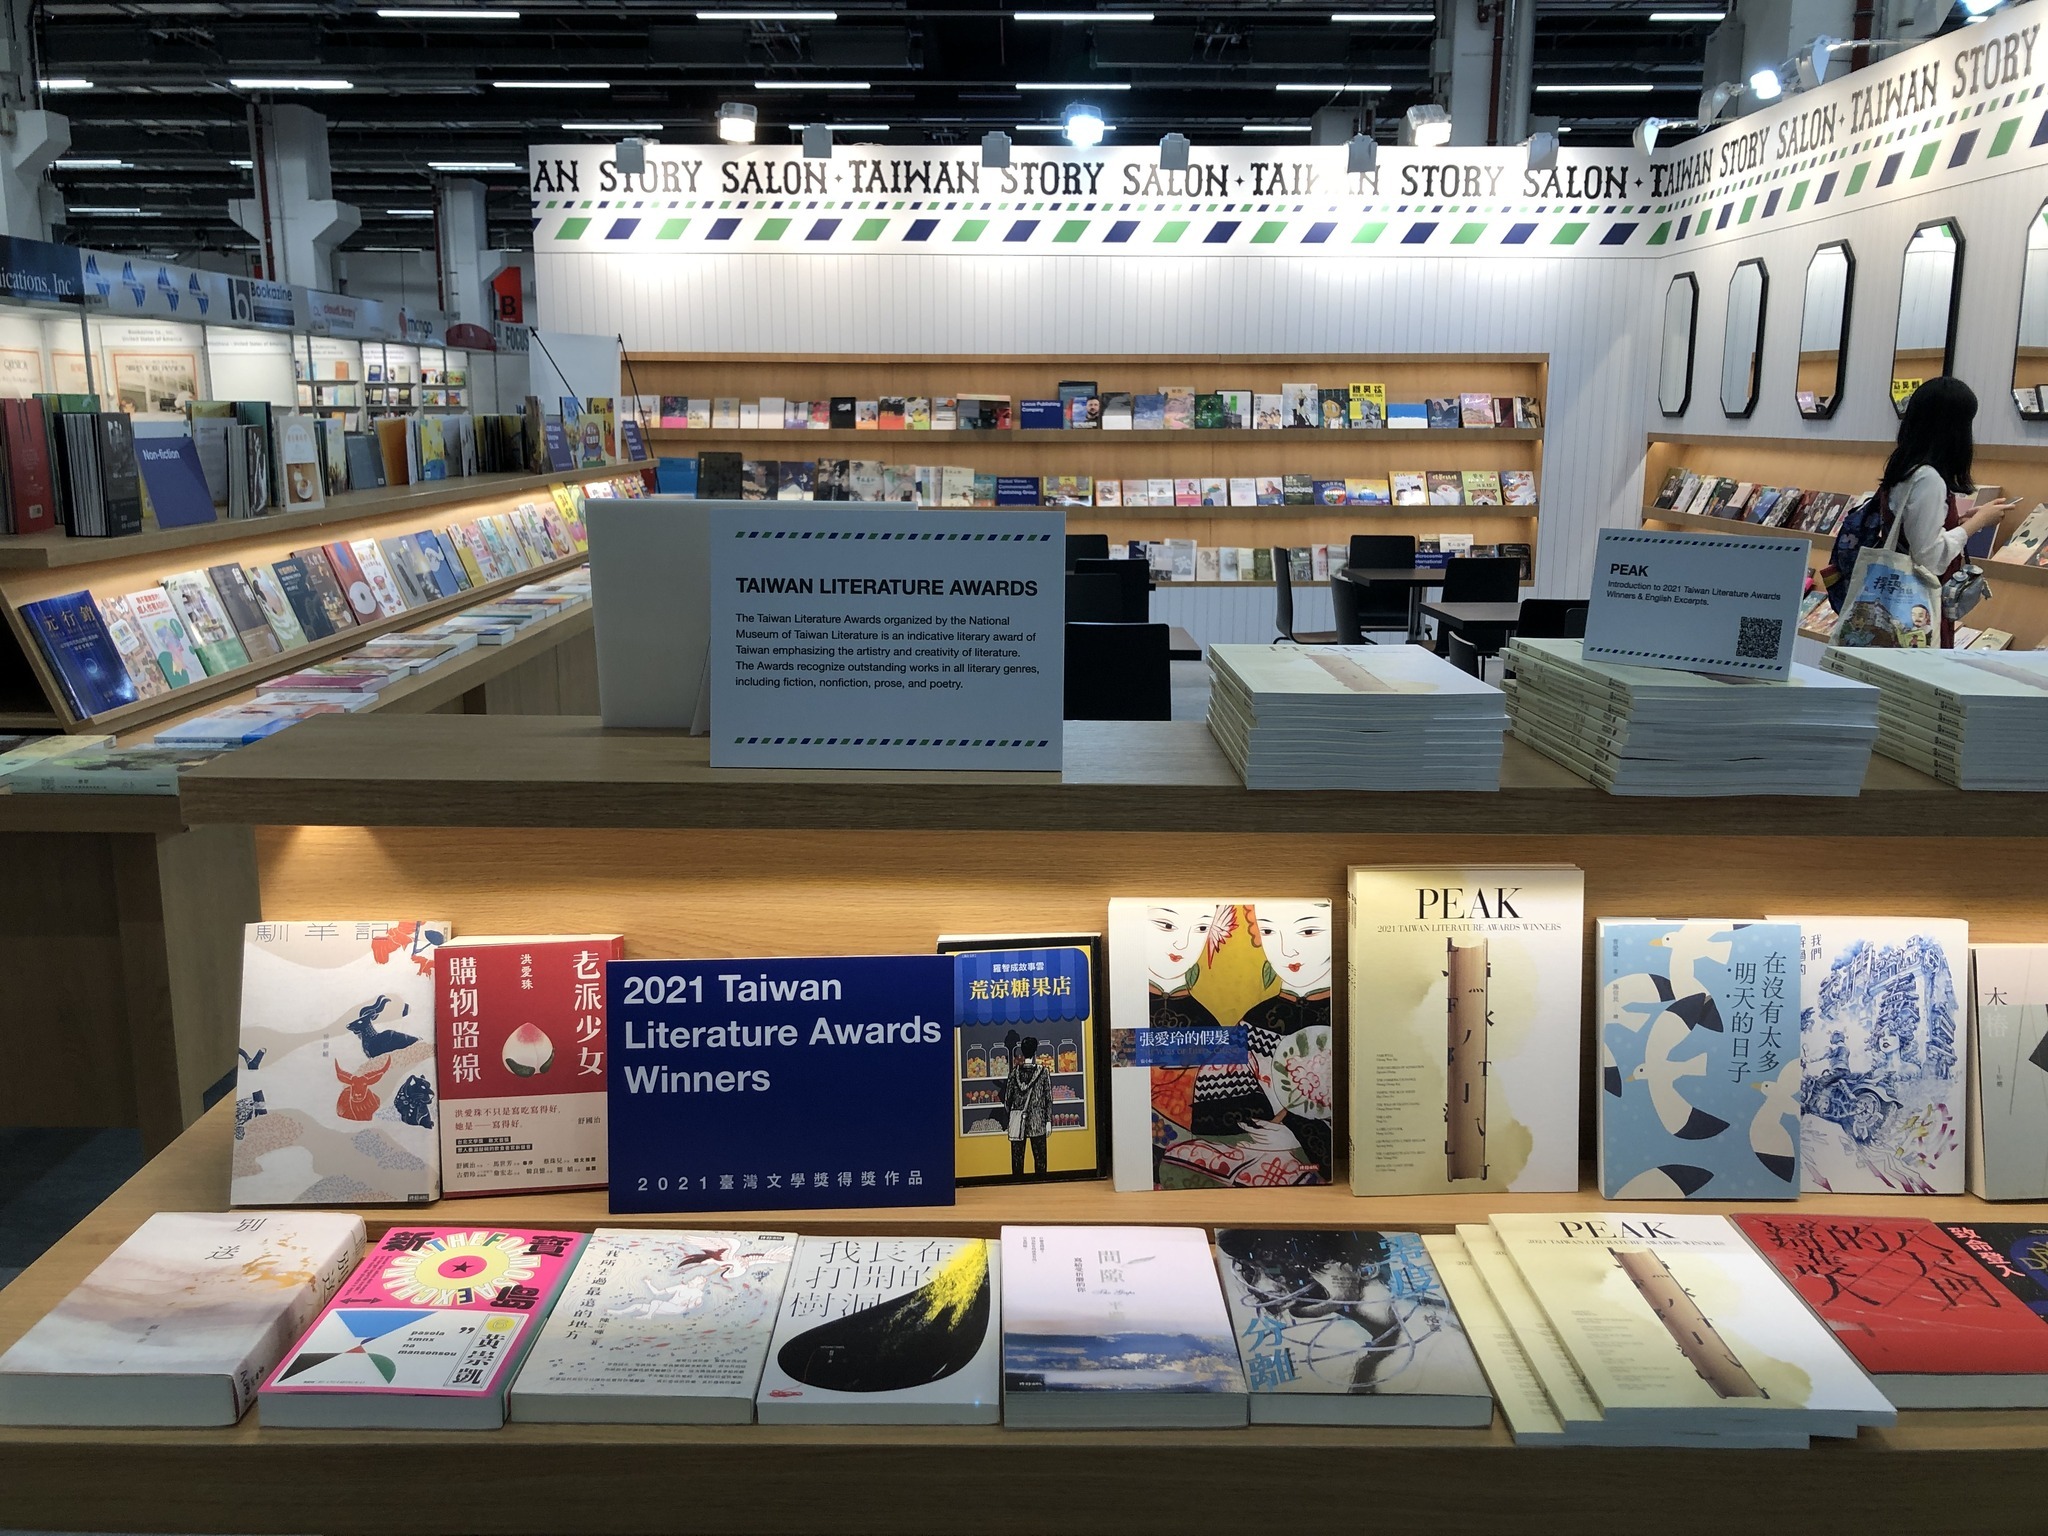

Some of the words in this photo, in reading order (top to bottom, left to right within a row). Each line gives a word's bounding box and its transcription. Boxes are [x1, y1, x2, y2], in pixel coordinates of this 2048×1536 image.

[1649, 148, 1714, 197] TAIWAN
[1719, 126, 1771, 178] STORY
[1777, 103, 1838, 160] SALON
[1850, 60, 1941, 134] TAIWAN
[1952, 24, 2041, 98] STORY
[600, 160, 703, 193] STORY
[722, 161, 828, 194] SALON
[849, 161, 980, 194] TAIWAN
[1001, 162, 1105, 195] STORY
[1122, 163, 1228, 197] SALON
[1401, 165, 1503, 198] STORY
[1523, 166, 1629, 199] SALON
[250, 282, 293, 301] Bookazine
[501, 296, 516, 316] B
[143, 449, 180, 461] Non-fiction
[1610, 563, 1649, 577] PEAK
[736, 577, 814, 594] TAIWAN
[820, 578, 944, 595] LITERATURE
[949, 580, 1038, 596] AWARDS
[1608, 581, 1651, 591] Introduction
[1663, 584, 1681, 592] 2021
[1684, 586, 1709, 595] Taiwan
[1712, 588, 1748, 598] Literature
[1750, 591, 1781, 600] Awards
[1607, 590, 1636, 600] Winners
[1645, 594, 1672, 604] English
[1674, 595, 1709, 605] Excerpts.
[736, 613, 754, 624] The
[757, 613, 791, 624] Taiwan
[794, 614, 841, 625] Literature
[844, 615, 881, 625] Awards
[884, 615, 932, 627] organized
[935, 616, 948, 627] by
[950, 616, 966, 625] the
[969, 616, 1010, 626] National
[736, 629, 779, 639] Museum
[781, 629, 791, 639] of
[794, 630, 829, 640] Taiwan
[831, 630, 878, 640] Literature
[881, 631, 890, 640] is
[892, 633, 905, 641] an
[907, 631, 954, 641] indicative
[956, 631, 990, 644] literary
[993, 632, 1023, 642] award
[1025, 632, 1036, 642] of
[736, 645, 770, 655] Taiwan
[773, 645, 835, 658] emphasizing
[838, 646, 854, 656] the
[856, 647, 890, 658] artistry
[893, 647, 912, 657] and
[915, 647, 959, 659] creativity
[962, 648, 972, 657] of
[974, 648, 1020, 658] literature.
[736, 661, 754, 671] The
[757, 661, 794, 672] Awards
[797, 662, 845, 674] recognize
[848, 662, 906, 675] outstanding
[910, 663, 939, 673] works
[942, 663, 950, 673] in
[953, 663, 964, 673] all
[967, 663, 1000, 676] literary
[1003, 665, 1039, 676] genres,
[736, 677, 780, 689] including
[783, 677, 816, 689] fiction,
[819, 678, 871, 689] nonfiction,
[874, 680, 905, 691] prose,
[908, 679, 926, 689] and
[929, 680, 963, 691] poetry.
[1415, 888, 1523, 920] PEAK
[255, 922, 389, 942] 馴羊記
[1377, 925, 1396, 933] 2021
[1398, 924, 1430, 933] TAIWAN
[1432, 924, 1484, 932] LITERATURE
[1486, 924, 1520, 932] AWARDS
[1522, 923, 1561, 931] WINNERS
[520, 954, 533, 990] 洪愛珠
[993, 962, 1045, 973] 羅智成故事雲
[624, 976, 702, 1005] 2021
[718, 974, 842, 1004] Taiwan
[969, 976, 1071, 1000] 荒涼糖果店
[449, 957, 481, 1083] 購物路線
[572, 951, 604, 1076] 老派少女
[1757, 951, 1787, 1073] 在沒有太多
[625, 1018, 798, 1050] Literature
[809, 1015, 942, 1046] Awards
[1728, 962, 1757, 1084] 明天的日子
[1140, 1030, 1230, 1047] 張愛玲的假髮
[624, 1065, 771, 1095] Winners
[1555, 1221, 1677, 1239] PEAK
[1947, 1227, 2026, 1278] 致命登入
[1242, 1316, 1302, 1392] 分離
